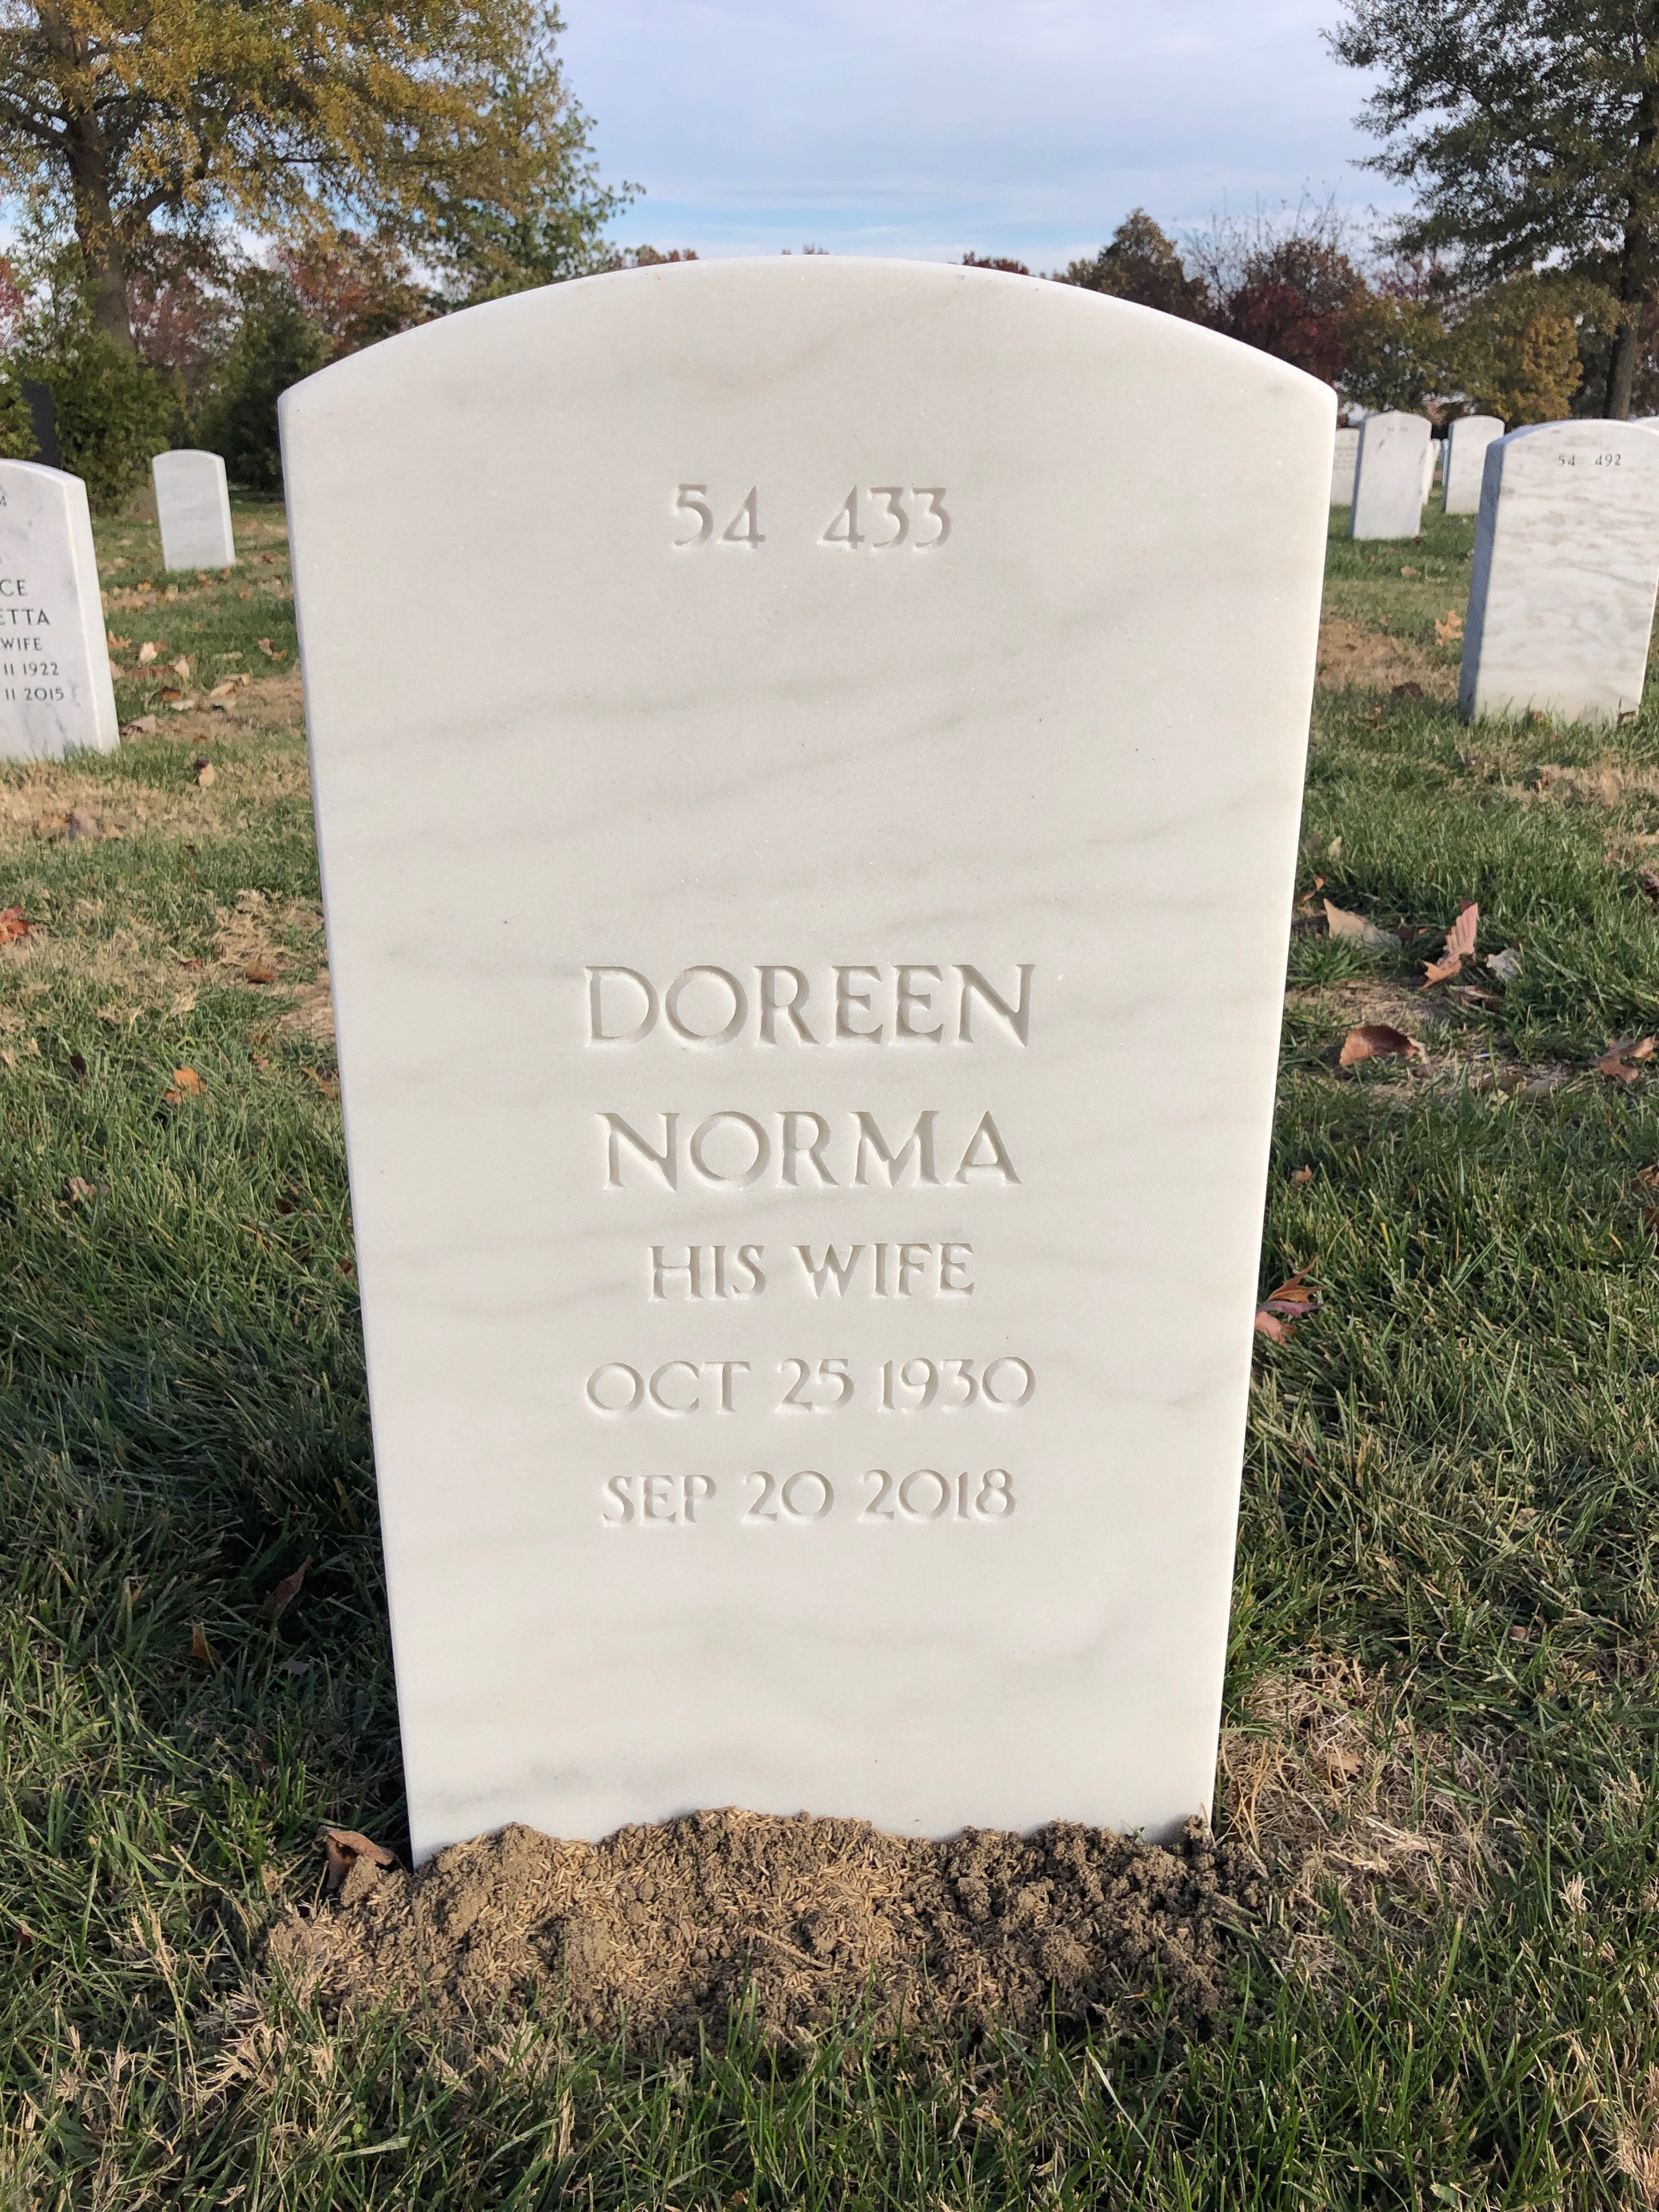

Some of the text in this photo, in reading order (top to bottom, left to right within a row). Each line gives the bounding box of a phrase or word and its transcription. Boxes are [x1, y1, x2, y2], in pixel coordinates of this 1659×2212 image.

[1558, 453, 1621, 466] 54 492
[672, 483, 952, 550] 54 433
[0, 578, 28, 596] CE
[0, 637, 42, 651] WIFE
[23, 661, 59, 676] 1922
[24, 686, 64, 701] 2015
[584, 964, 1036, 1048] DOREEN
[596, 1110, 1022, 1191] NORMA
[648, 1242, 975, 1302] HIS WIFE
[585, 1356, 1036, 1417] OCT 25 1930
[602, 1467, 1017, 1527] SEP 20 2018
